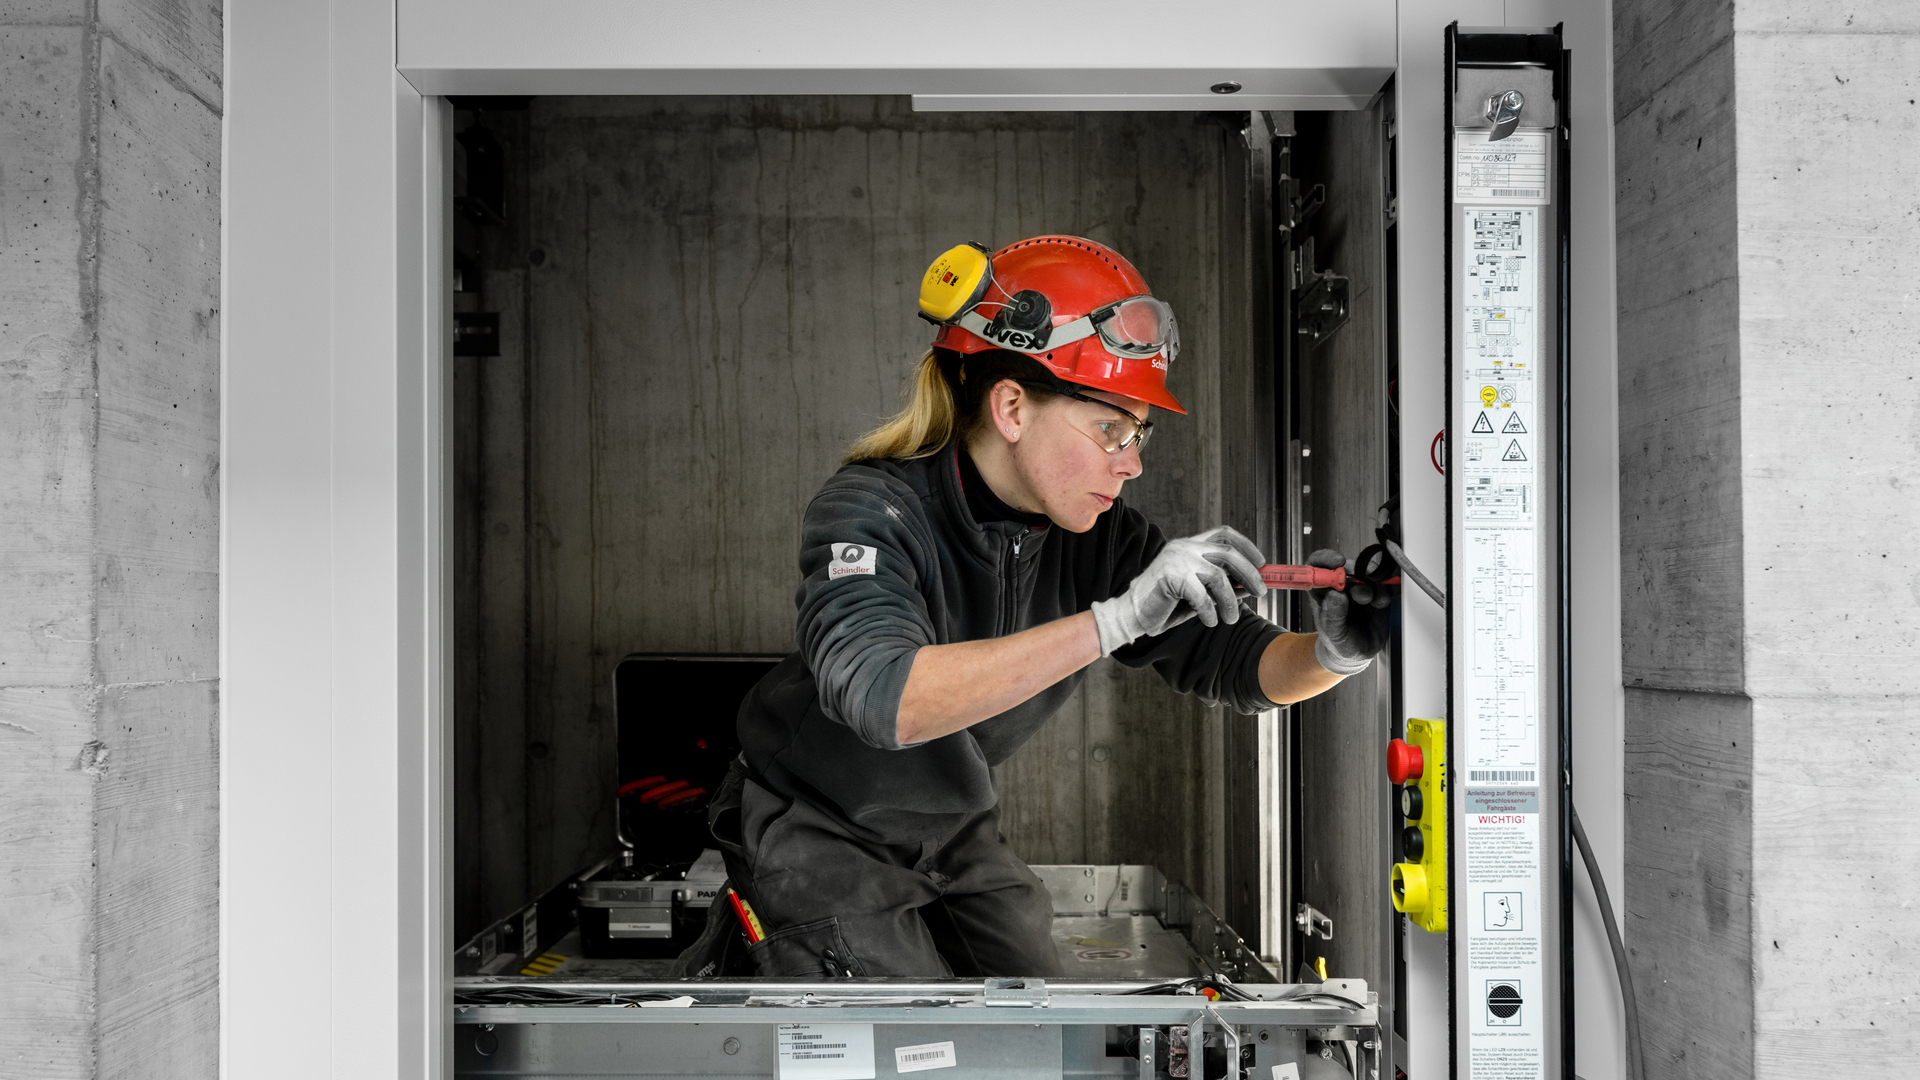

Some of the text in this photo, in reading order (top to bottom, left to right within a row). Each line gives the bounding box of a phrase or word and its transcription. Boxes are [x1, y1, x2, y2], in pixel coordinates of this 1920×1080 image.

[983, 322, 1044, 350] uvex
[833, 566, 870, 575] Schindler
[1414, 724, 1423, 733] STOP
